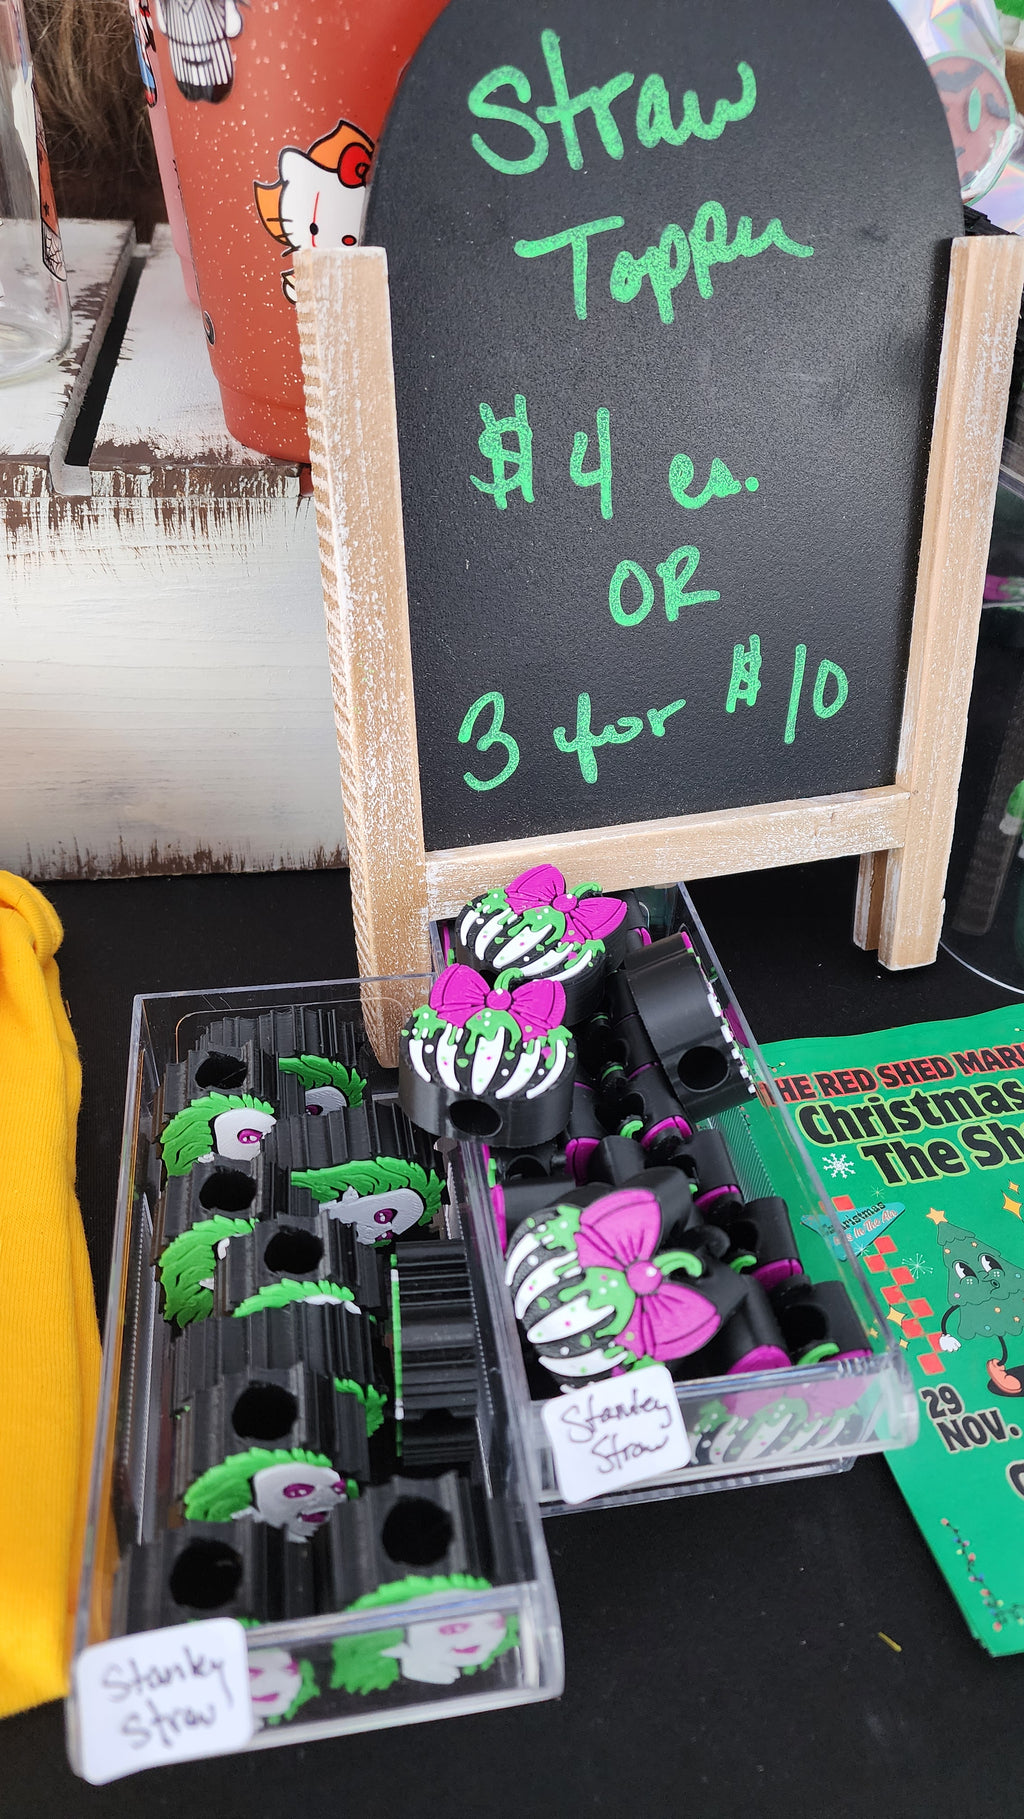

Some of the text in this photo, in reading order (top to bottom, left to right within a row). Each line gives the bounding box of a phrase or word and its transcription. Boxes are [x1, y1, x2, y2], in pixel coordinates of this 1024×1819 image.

[468, 30, 758, 176] Straw
[609, 546, 722, 628] OR
[458, 692, 521, 793] 3
[553, 693, 688, 785] for
[815, 1069, 877, 1098] RED
[877, 1056, 955, 1088] SHED
[799, 1080, 1024, 1145] Christmas
[861, 1122, 1024, 1184] The Sh
[821, 1201, 887, 1236] Cristmas
[864, 1218, 881, 1232] The
[920, 1385, 963, 1419] 29
[591, 1432, 669, 1474] Straw
[936, 1409, 1020, 1452] NOV.
[120, 1697, 217, 1751] Straw
